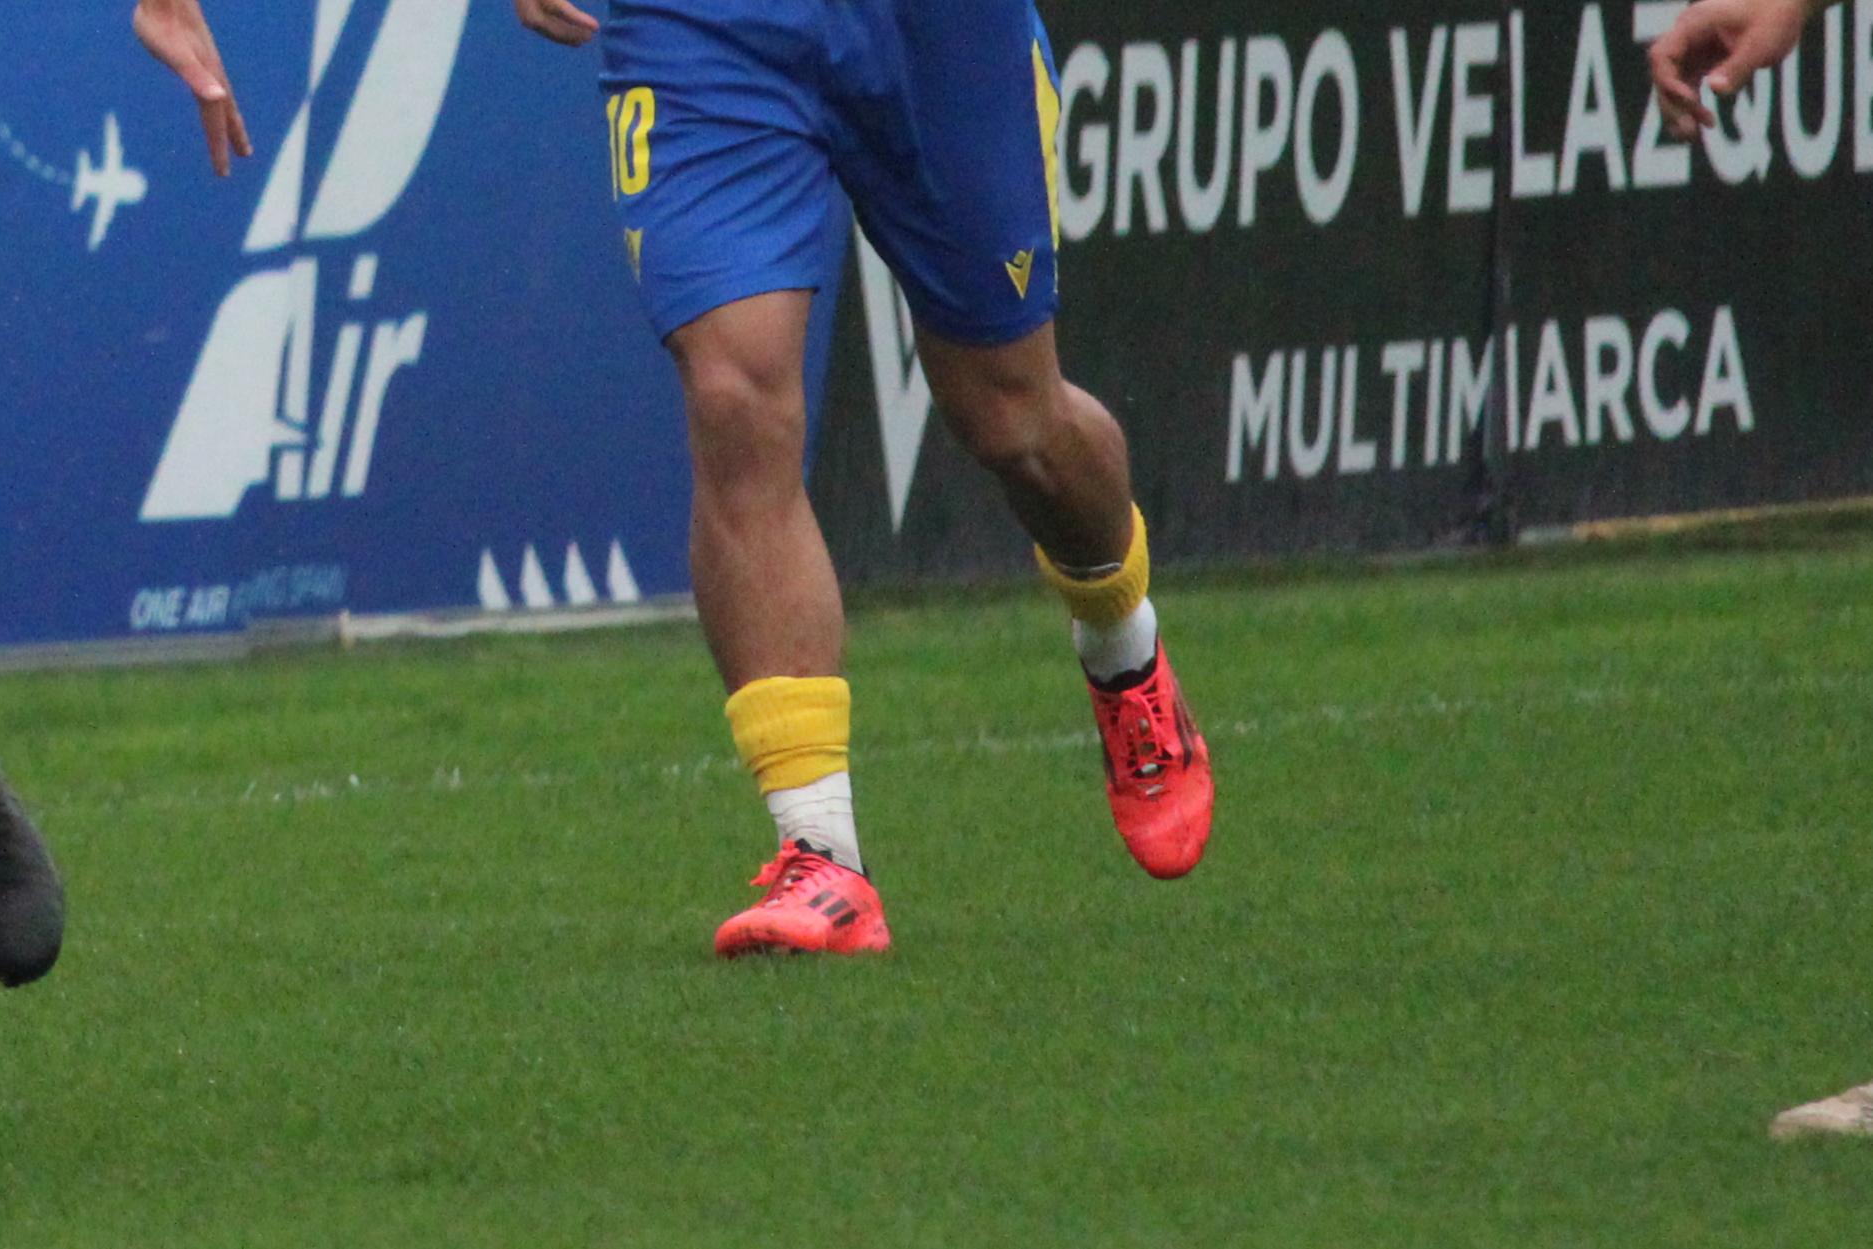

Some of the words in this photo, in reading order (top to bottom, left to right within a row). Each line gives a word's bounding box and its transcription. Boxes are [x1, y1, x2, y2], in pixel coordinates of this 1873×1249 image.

[607, 86, 656, 201] 10
[1058, 29, 1359, 242] GRUPO
[1223, 306, 1756, 483] MULTIMARCA
